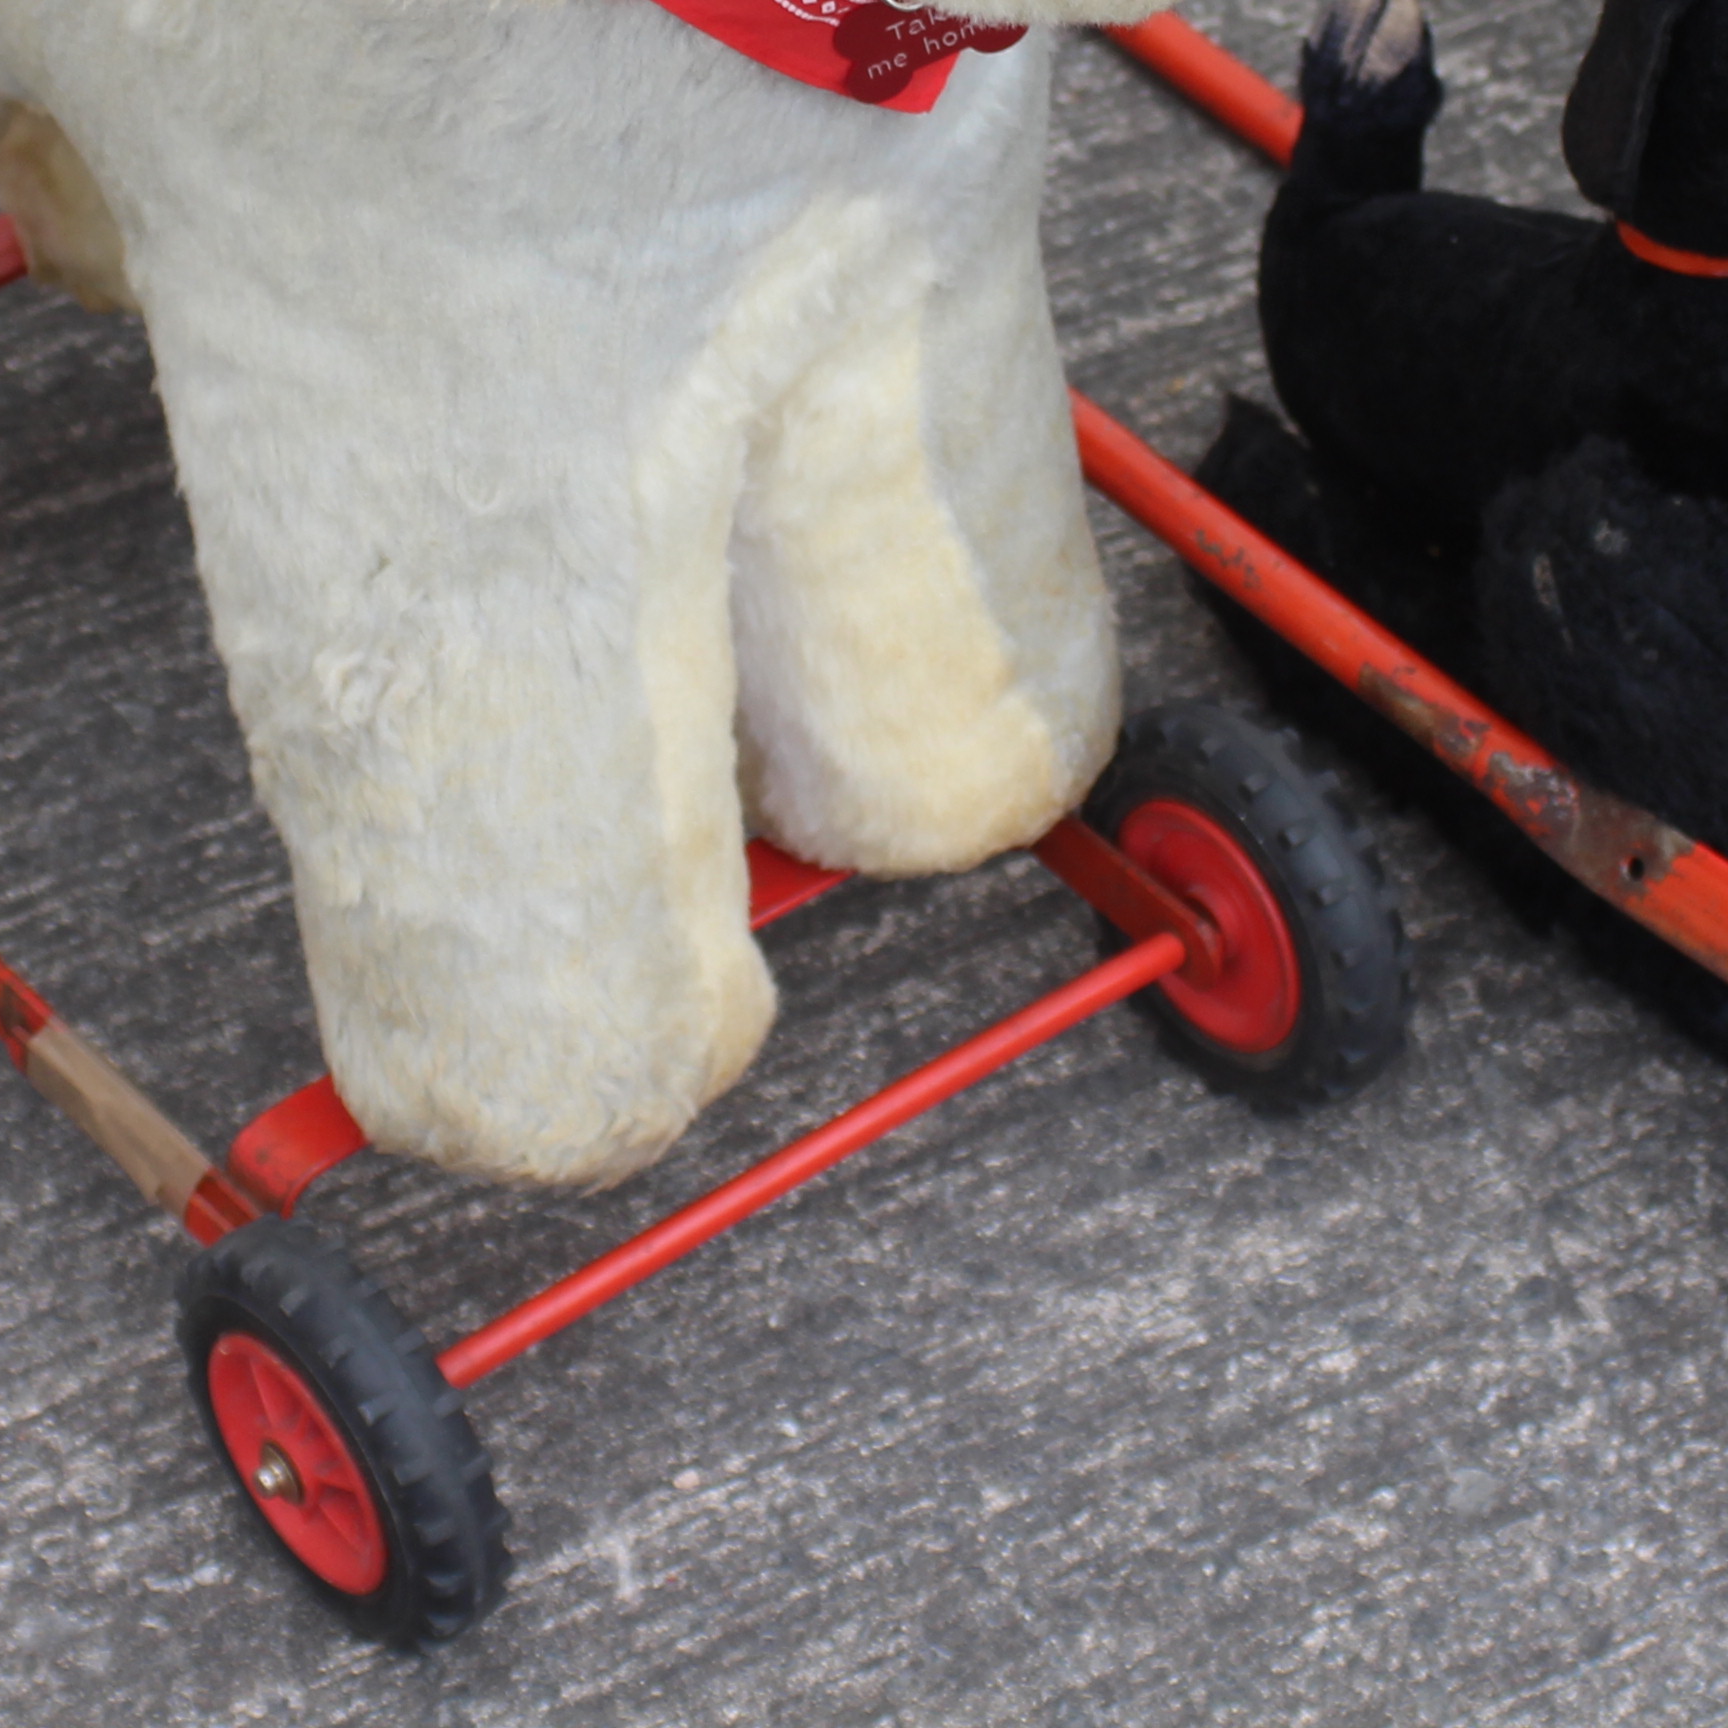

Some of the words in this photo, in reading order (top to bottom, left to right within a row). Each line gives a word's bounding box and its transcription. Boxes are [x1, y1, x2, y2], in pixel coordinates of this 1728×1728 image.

[885, 8, 948, 40] Tak
[867, 52, 907, 79] me
[923, 23, 1001, 54] hom
